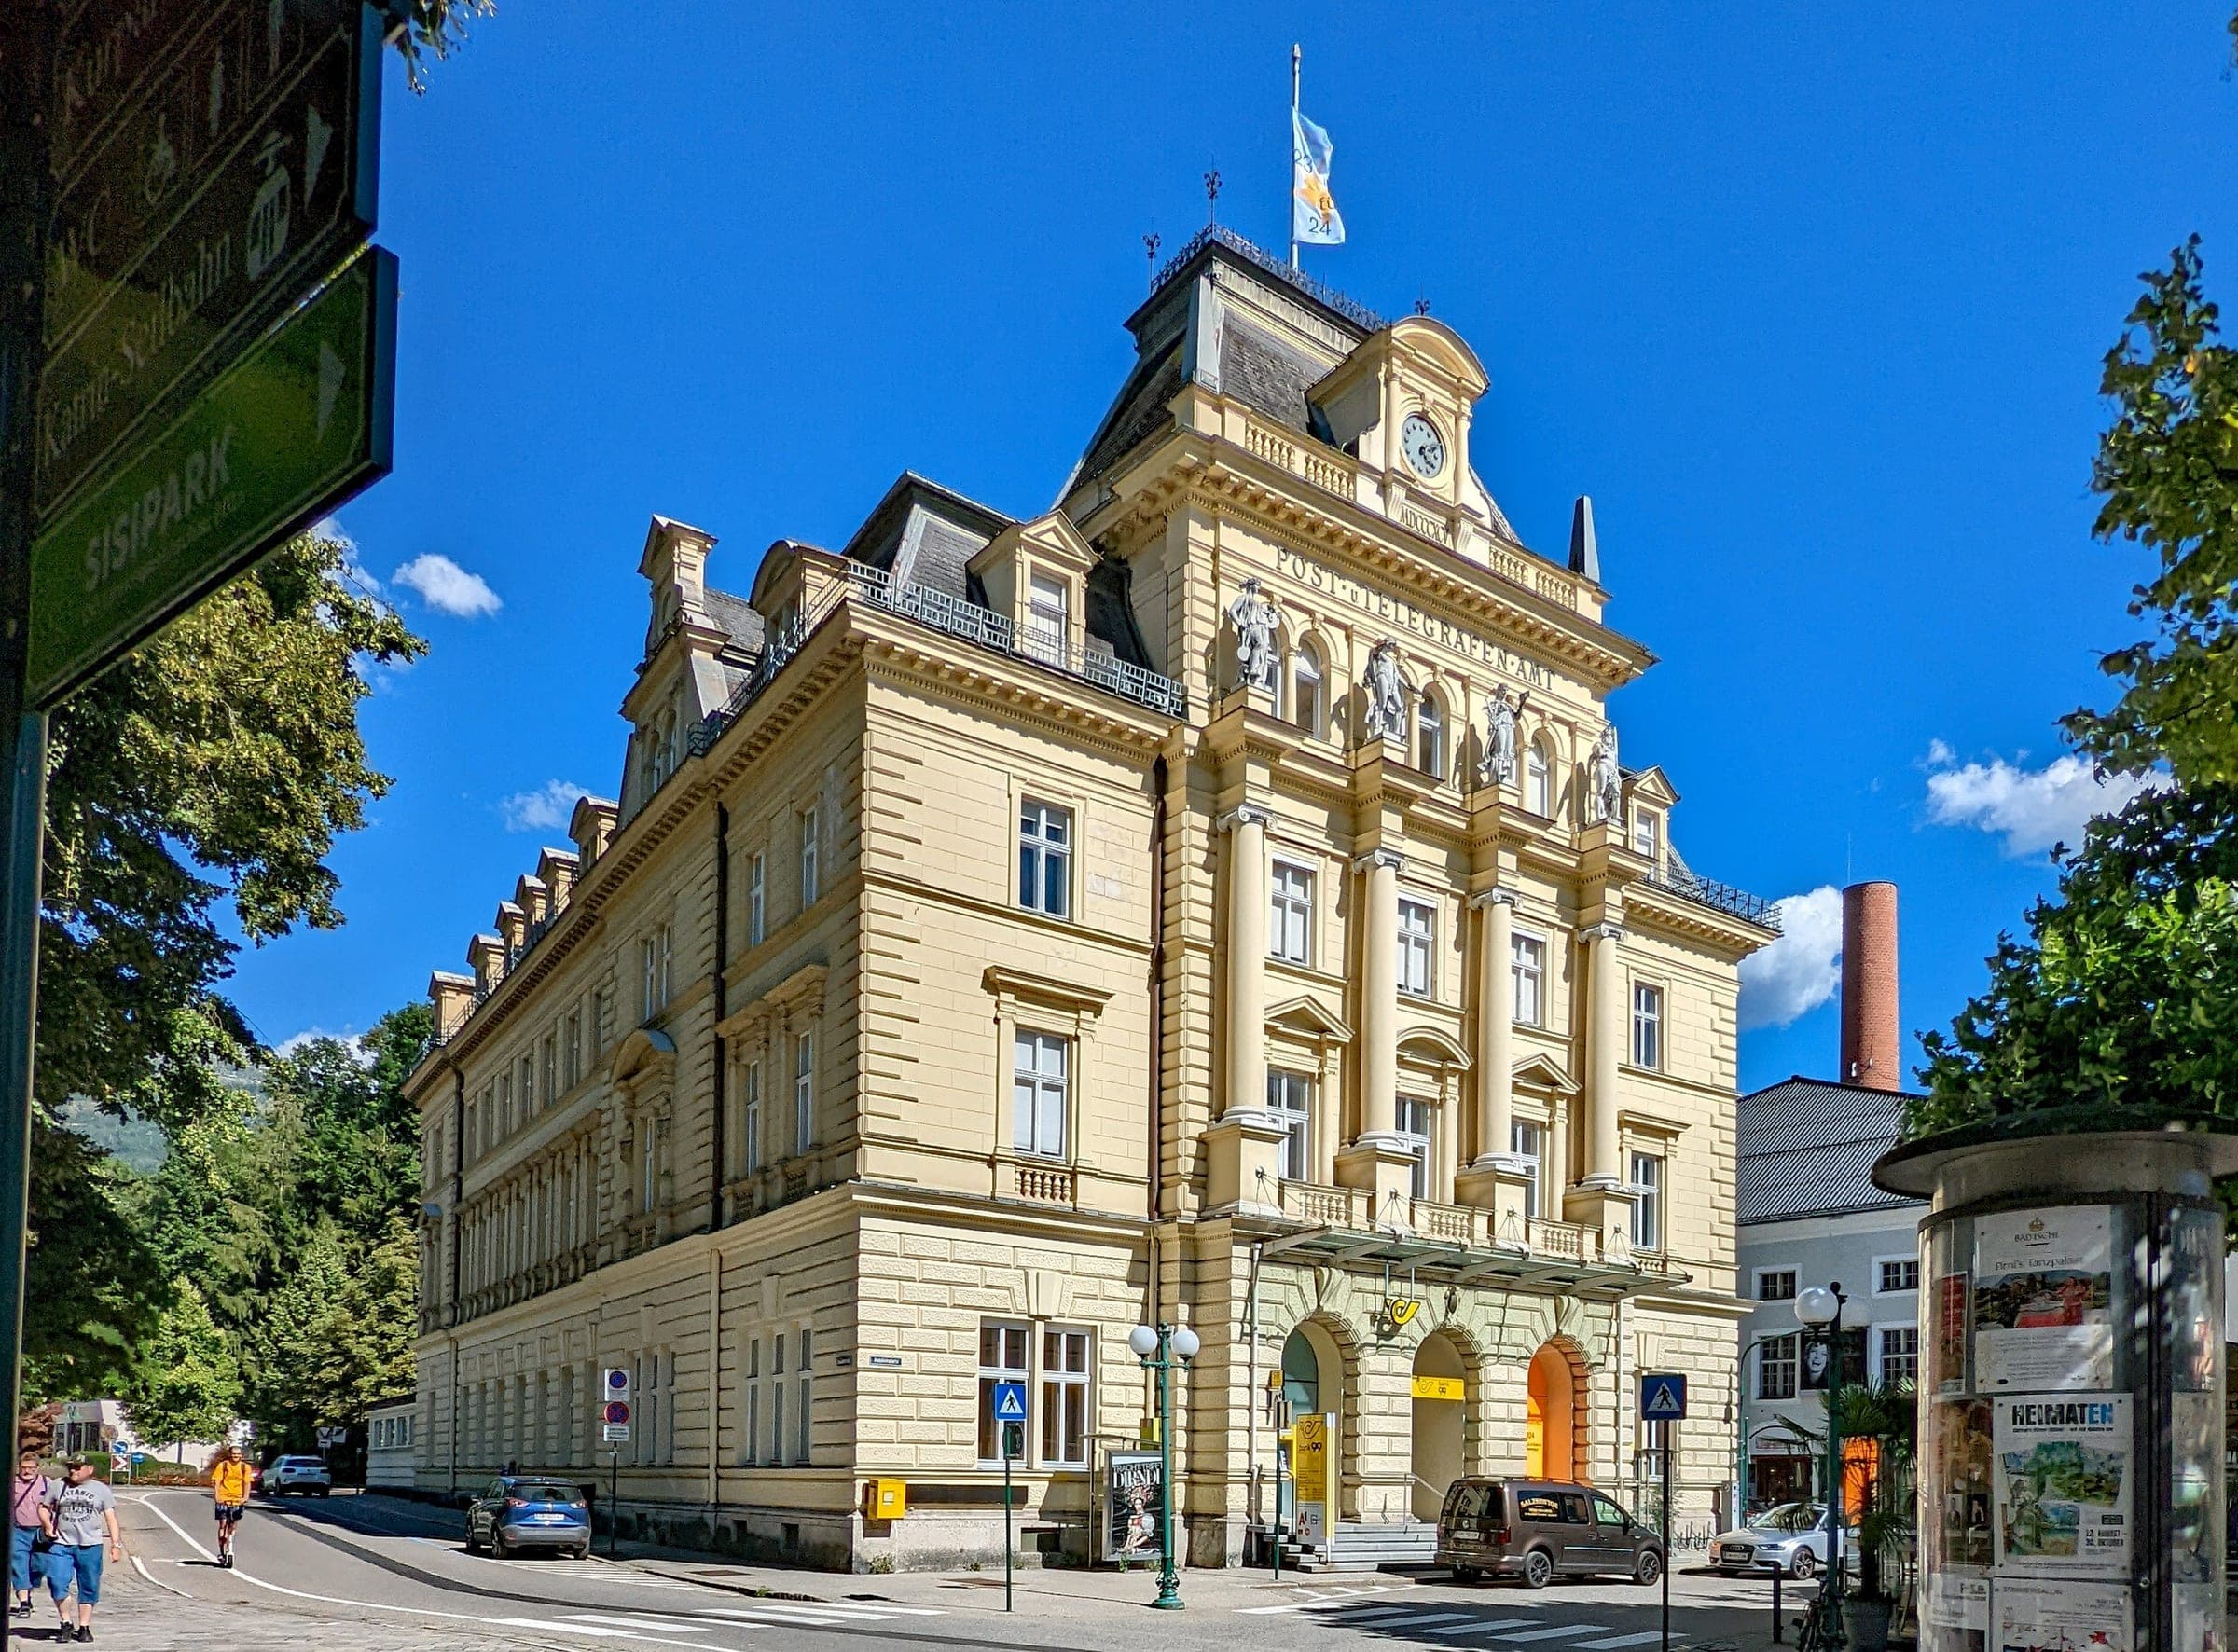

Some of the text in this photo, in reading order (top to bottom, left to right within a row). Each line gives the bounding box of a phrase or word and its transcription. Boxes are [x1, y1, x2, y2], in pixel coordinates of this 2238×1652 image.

[1308, 217, 1332, 236] 24
[87, 421, 233, 593] SISIPARK
[2027, 1255, 2083, 1268] Tanzpal
[2012, 1403, 2114, 1425] HEIMATEN
